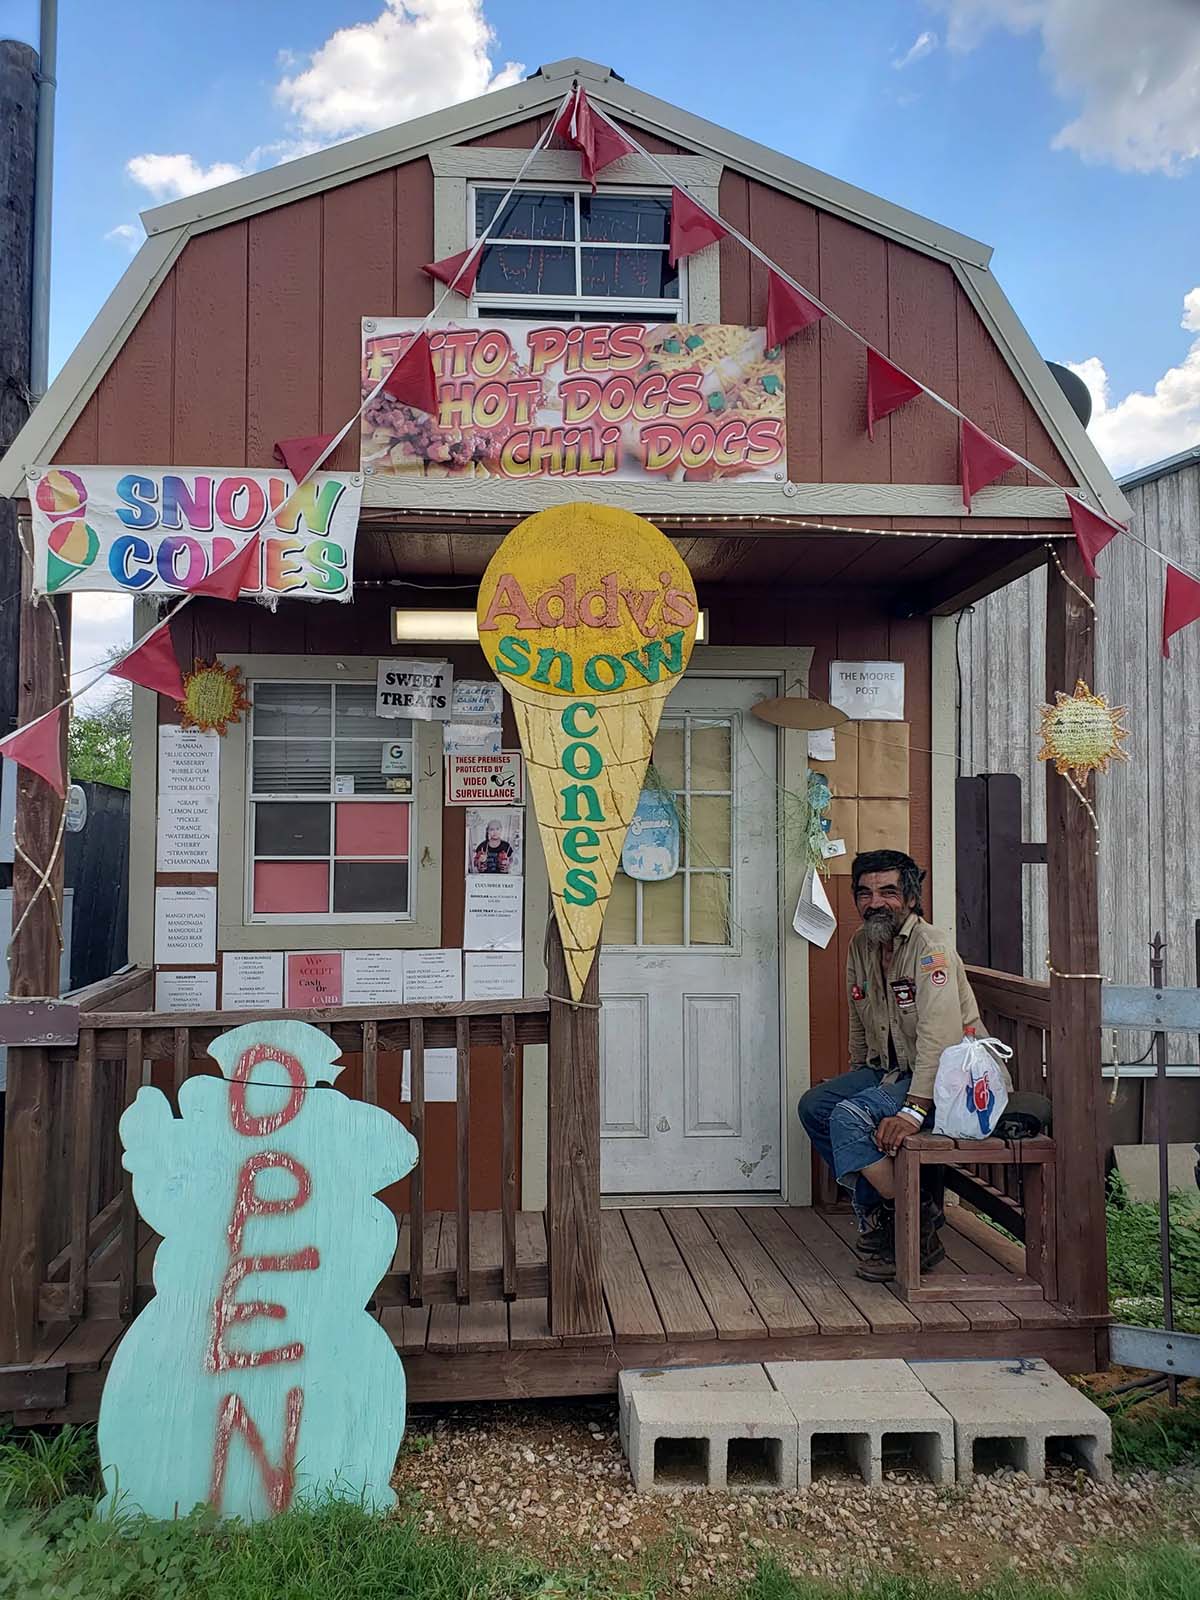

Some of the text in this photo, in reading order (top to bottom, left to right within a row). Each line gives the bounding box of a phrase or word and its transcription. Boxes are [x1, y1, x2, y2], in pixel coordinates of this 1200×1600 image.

[437, 374, 703, 430] HOT DOGS
[641, 419, 782, 471] DOGS
[115, 474, 347, 535] SNOW
[479, 571, 696, 638] Addy's
[385, 673, 444, 688] SWEET
[840, 672, 896, 681] THE MOORE
[855, 687, 880, 695] POST
[381, 692, 447, 708] TREATS
[456, 756, 511, 764] THESE PREMISES
[456, 765, 503, 773] PROTECTED BY
[463, 777, 488, 786] VIDEO
[456, 789, 516, 798] SURVEILLANCE
[304, 957, 322, 966] We
[299, 967, 333, 976] ACCEPT
[299, 979, 321, 987] Cash
[312, 995, 338, 1004] CARD
[204, 1043, 321, 1514] OPEN
